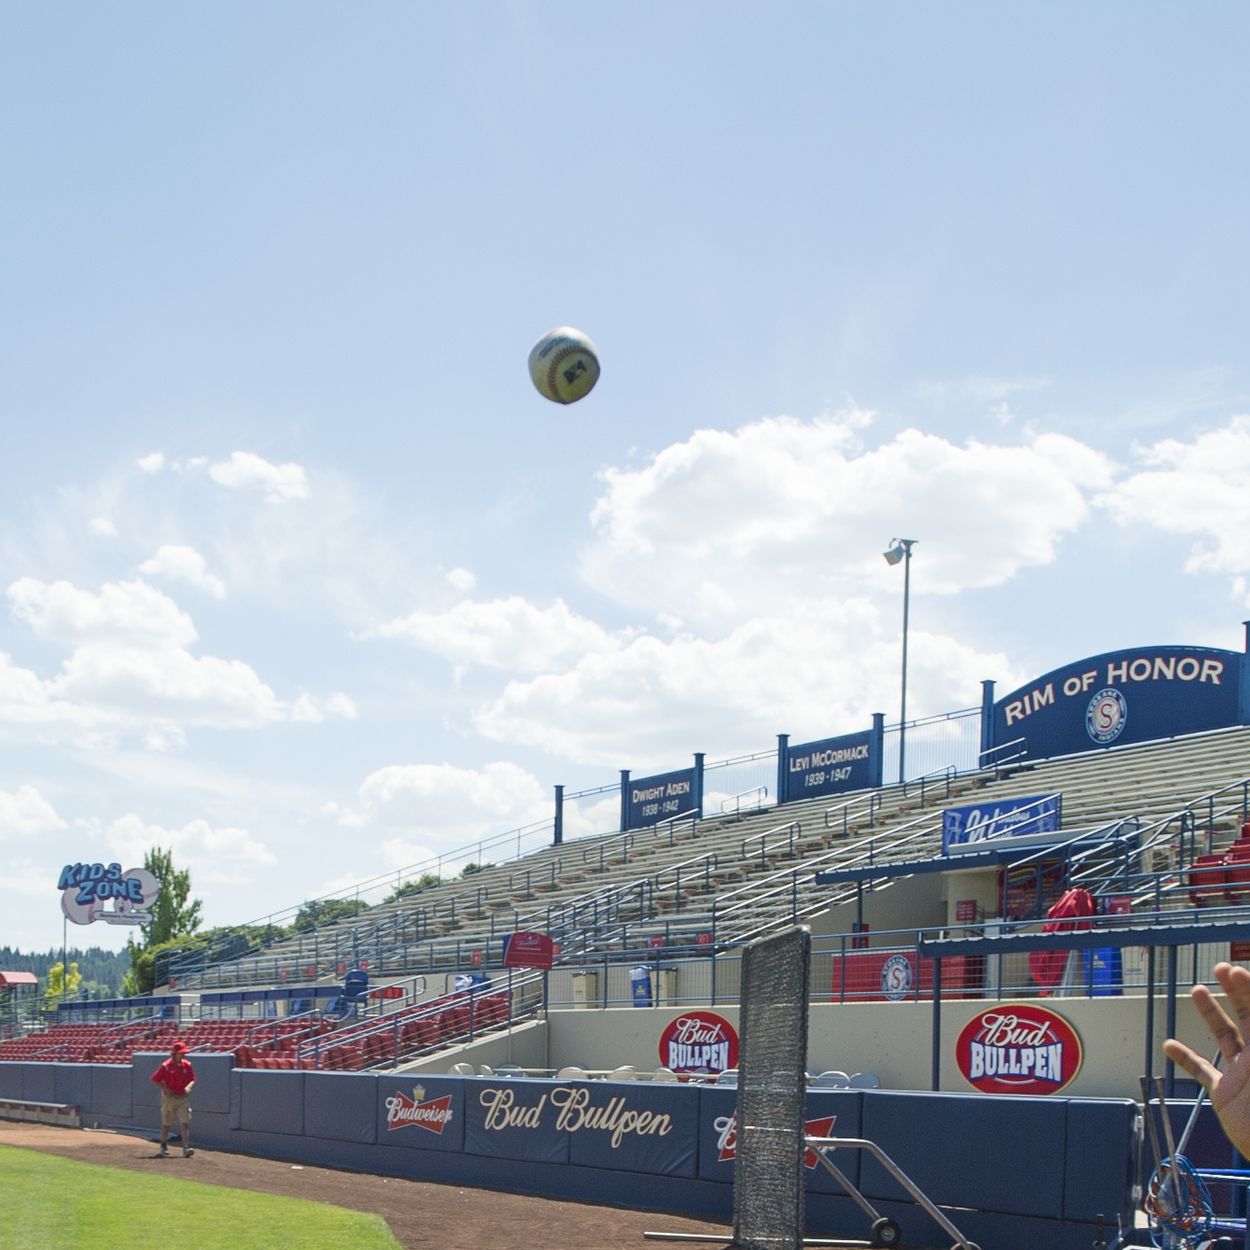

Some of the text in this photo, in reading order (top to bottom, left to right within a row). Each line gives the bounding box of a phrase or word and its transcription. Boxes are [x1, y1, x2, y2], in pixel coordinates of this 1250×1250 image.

[1004, 657, 1224, 726] RIM OF HONOR
[790, 757, 810, 772] LEVI
[632, 781, 690, 803] DWIGHT ADEN
[58, 862, 123, 890] KIDS
[75, 878, 144, 905] ZONE
[676, 1014, 721, 1045] Bud
[981, 1013, 1051, 1048] Bud
[668, 1039, 729, 1071] BULLPEN
[969, 1039, 1064, 1083] BULLPEN
[385, 1096, 453, 1124] Budweiser
[480, 1087, 548, 1130] Bud
[550, 1086, 673, 1149] Bullpen
